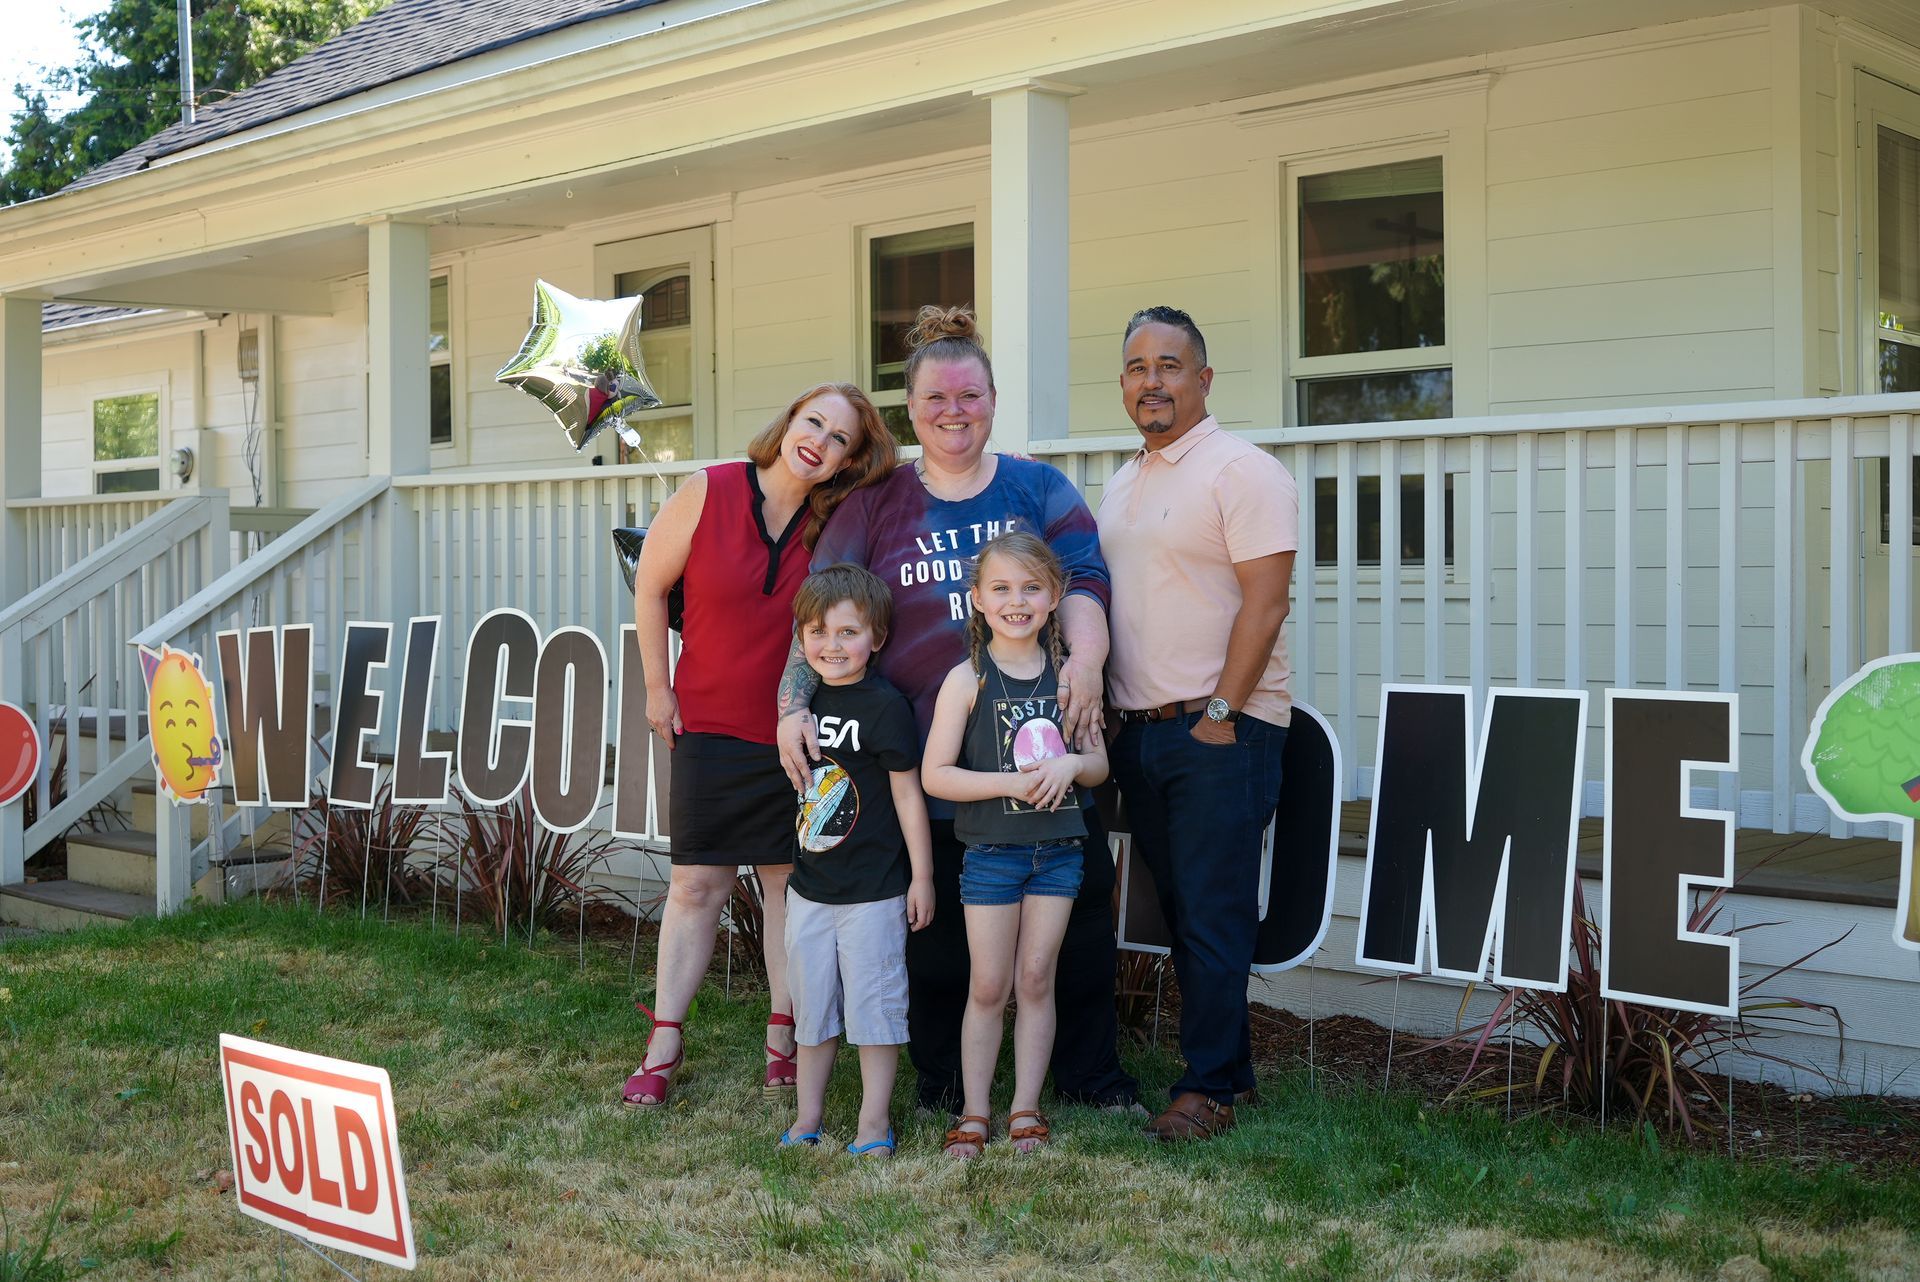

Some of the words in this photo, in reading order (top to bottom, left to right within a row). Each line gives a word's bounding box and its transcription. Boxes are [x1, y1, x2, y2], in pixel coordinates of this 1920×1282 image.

[916, 529, 958, 555] LET
[970, 520, 1016, 543] THE
[900, 559, 963, 586] GOOD
[813, 714, 861, 751] SA
[241, 1081, 379, 1215] SOLD
